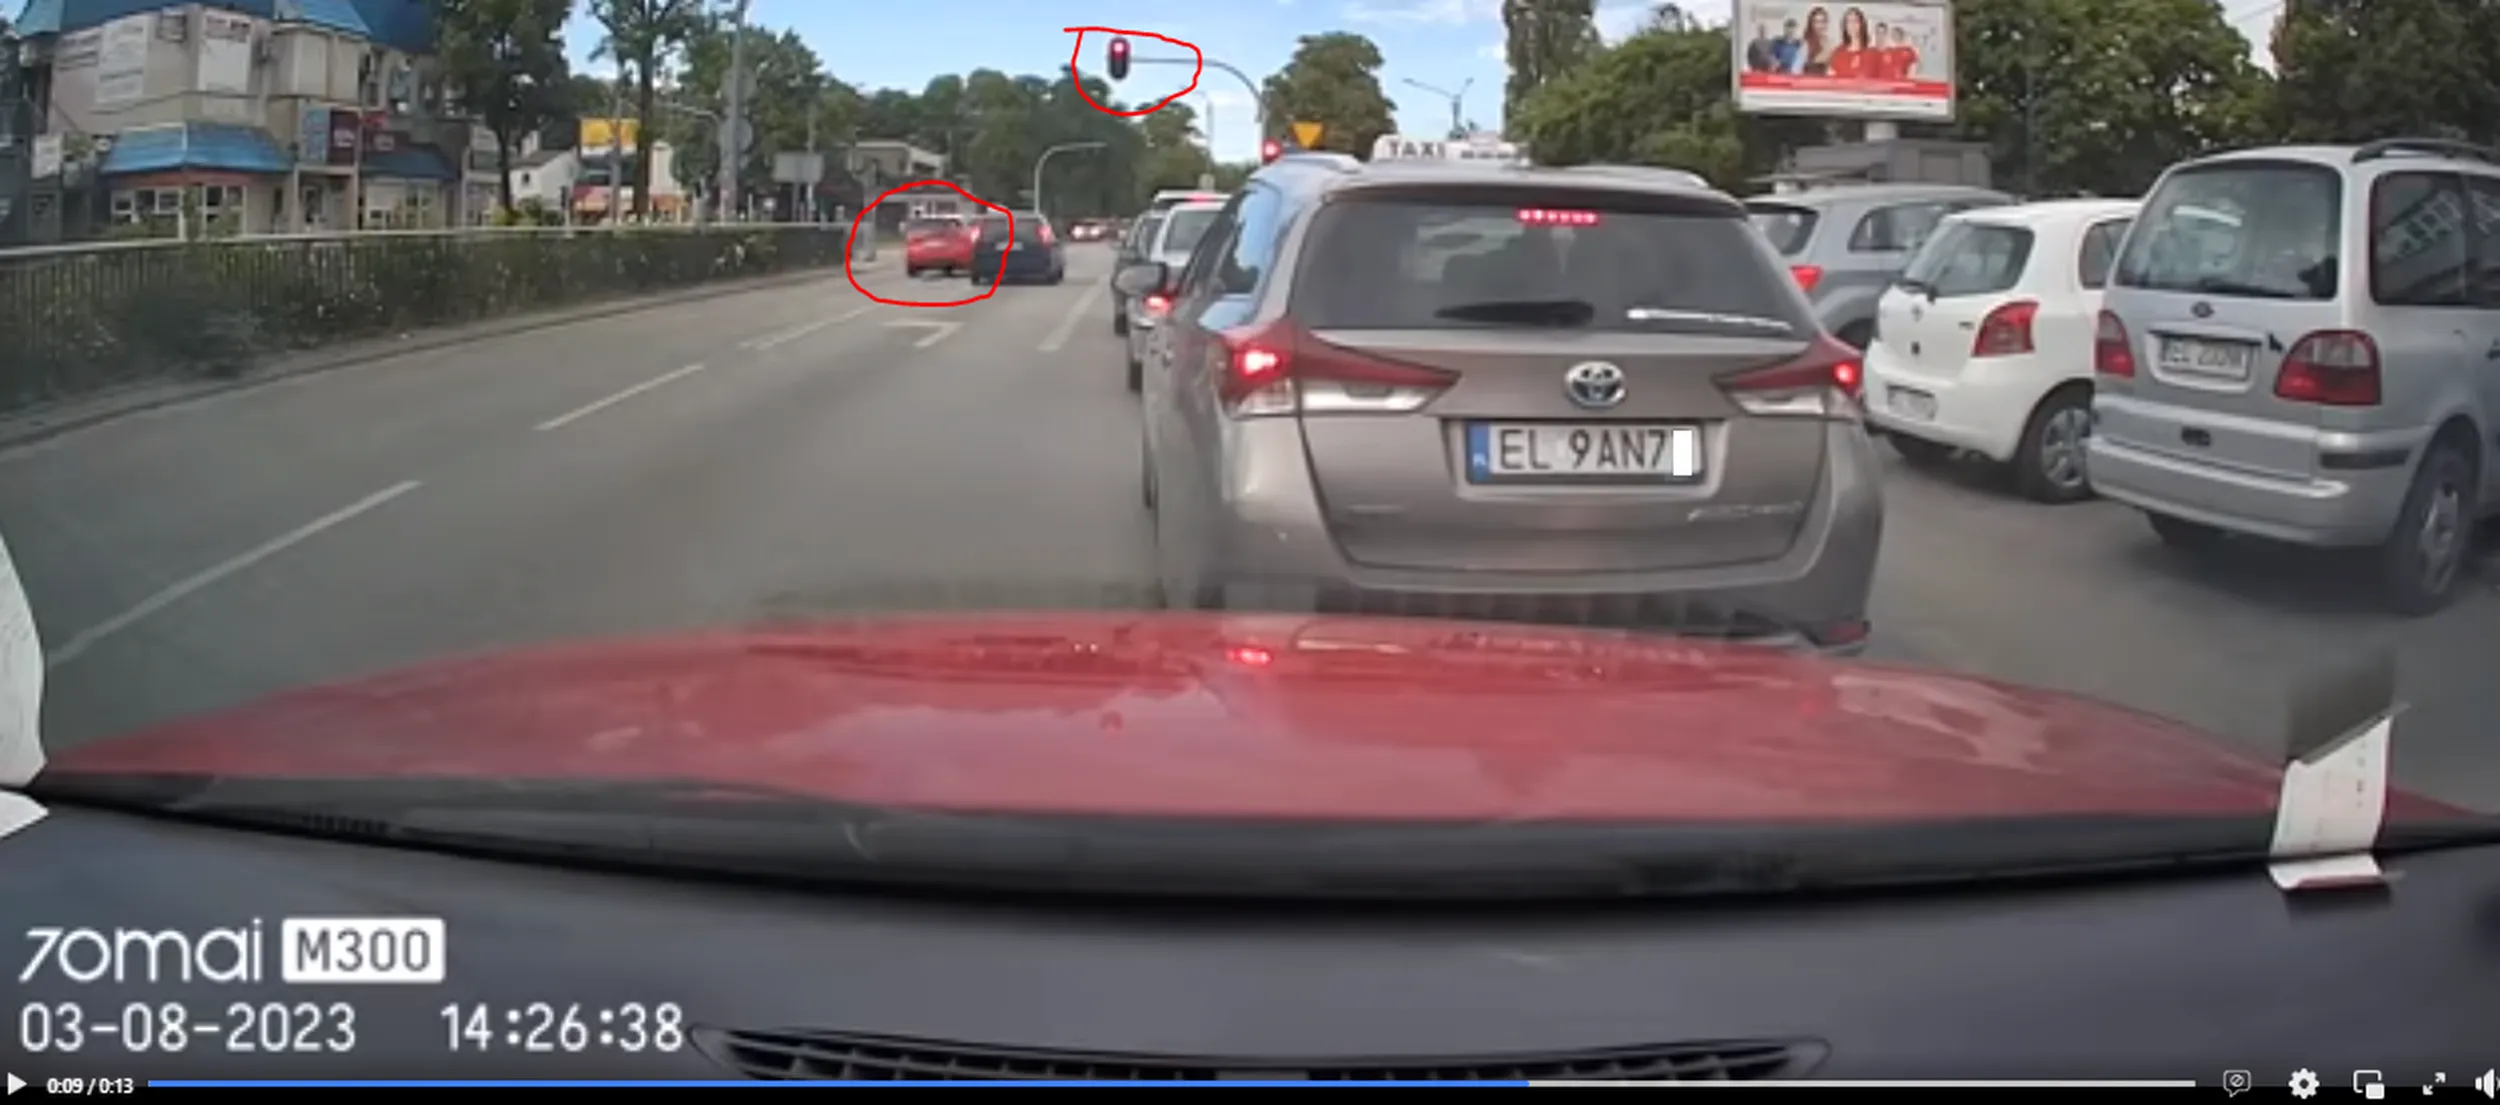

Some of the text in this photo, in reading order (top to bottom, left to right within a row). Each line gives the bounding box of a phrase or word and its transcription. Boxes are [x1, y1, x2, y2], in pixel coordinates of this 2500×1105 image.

[1389, 141, 1446, 159] TAXI
[1500, 429, 1693, 475] EL 9AN7
